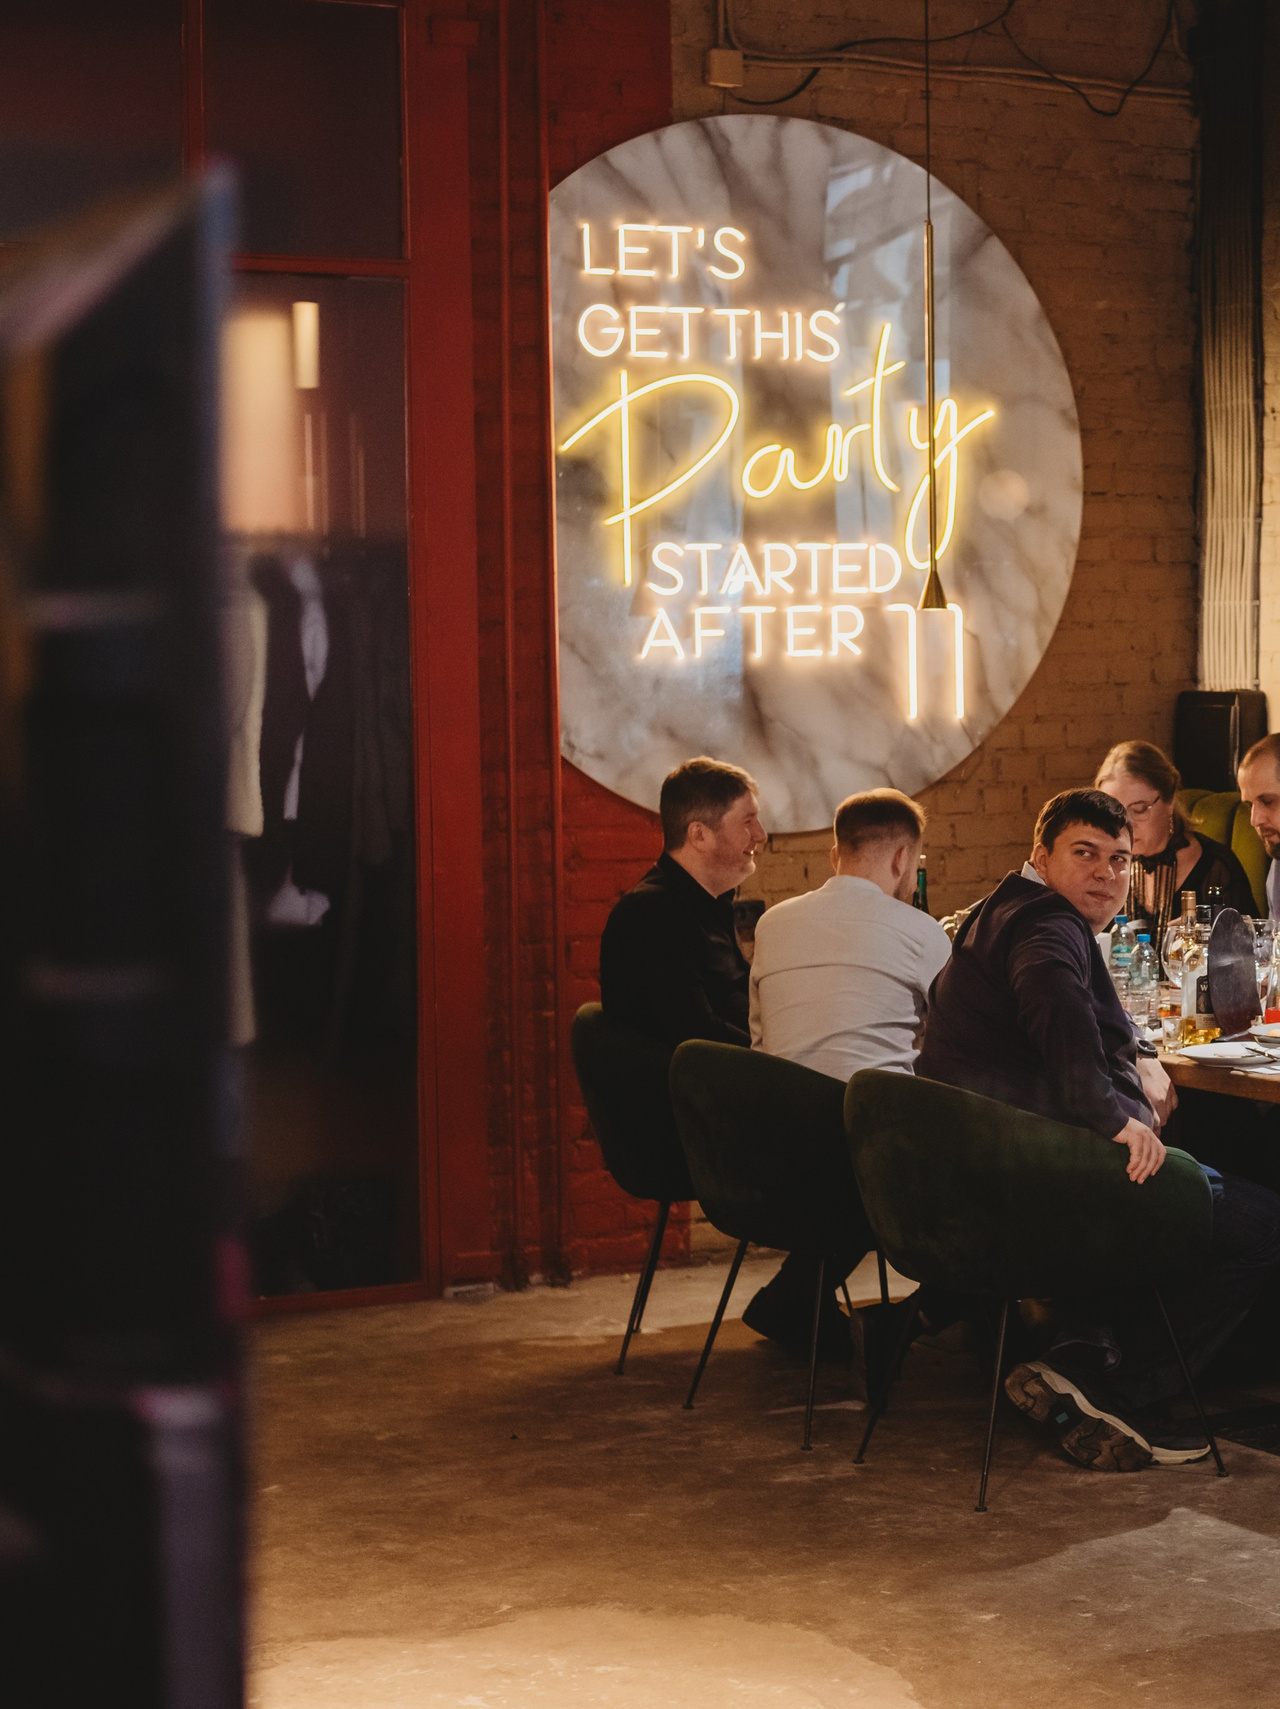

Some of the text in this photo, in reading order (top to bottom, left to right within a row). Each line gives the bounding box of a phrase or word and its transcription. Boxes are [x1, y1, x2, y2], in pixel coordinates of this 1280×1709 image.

[582, 223, 747, 279] LET'S
[578, 303, 841, 362] GET THIS
[559, 323, 995, 587] Party
[648, 542, 902, 596] STARTED
[640, 603, 965, 720] AFTER 11
